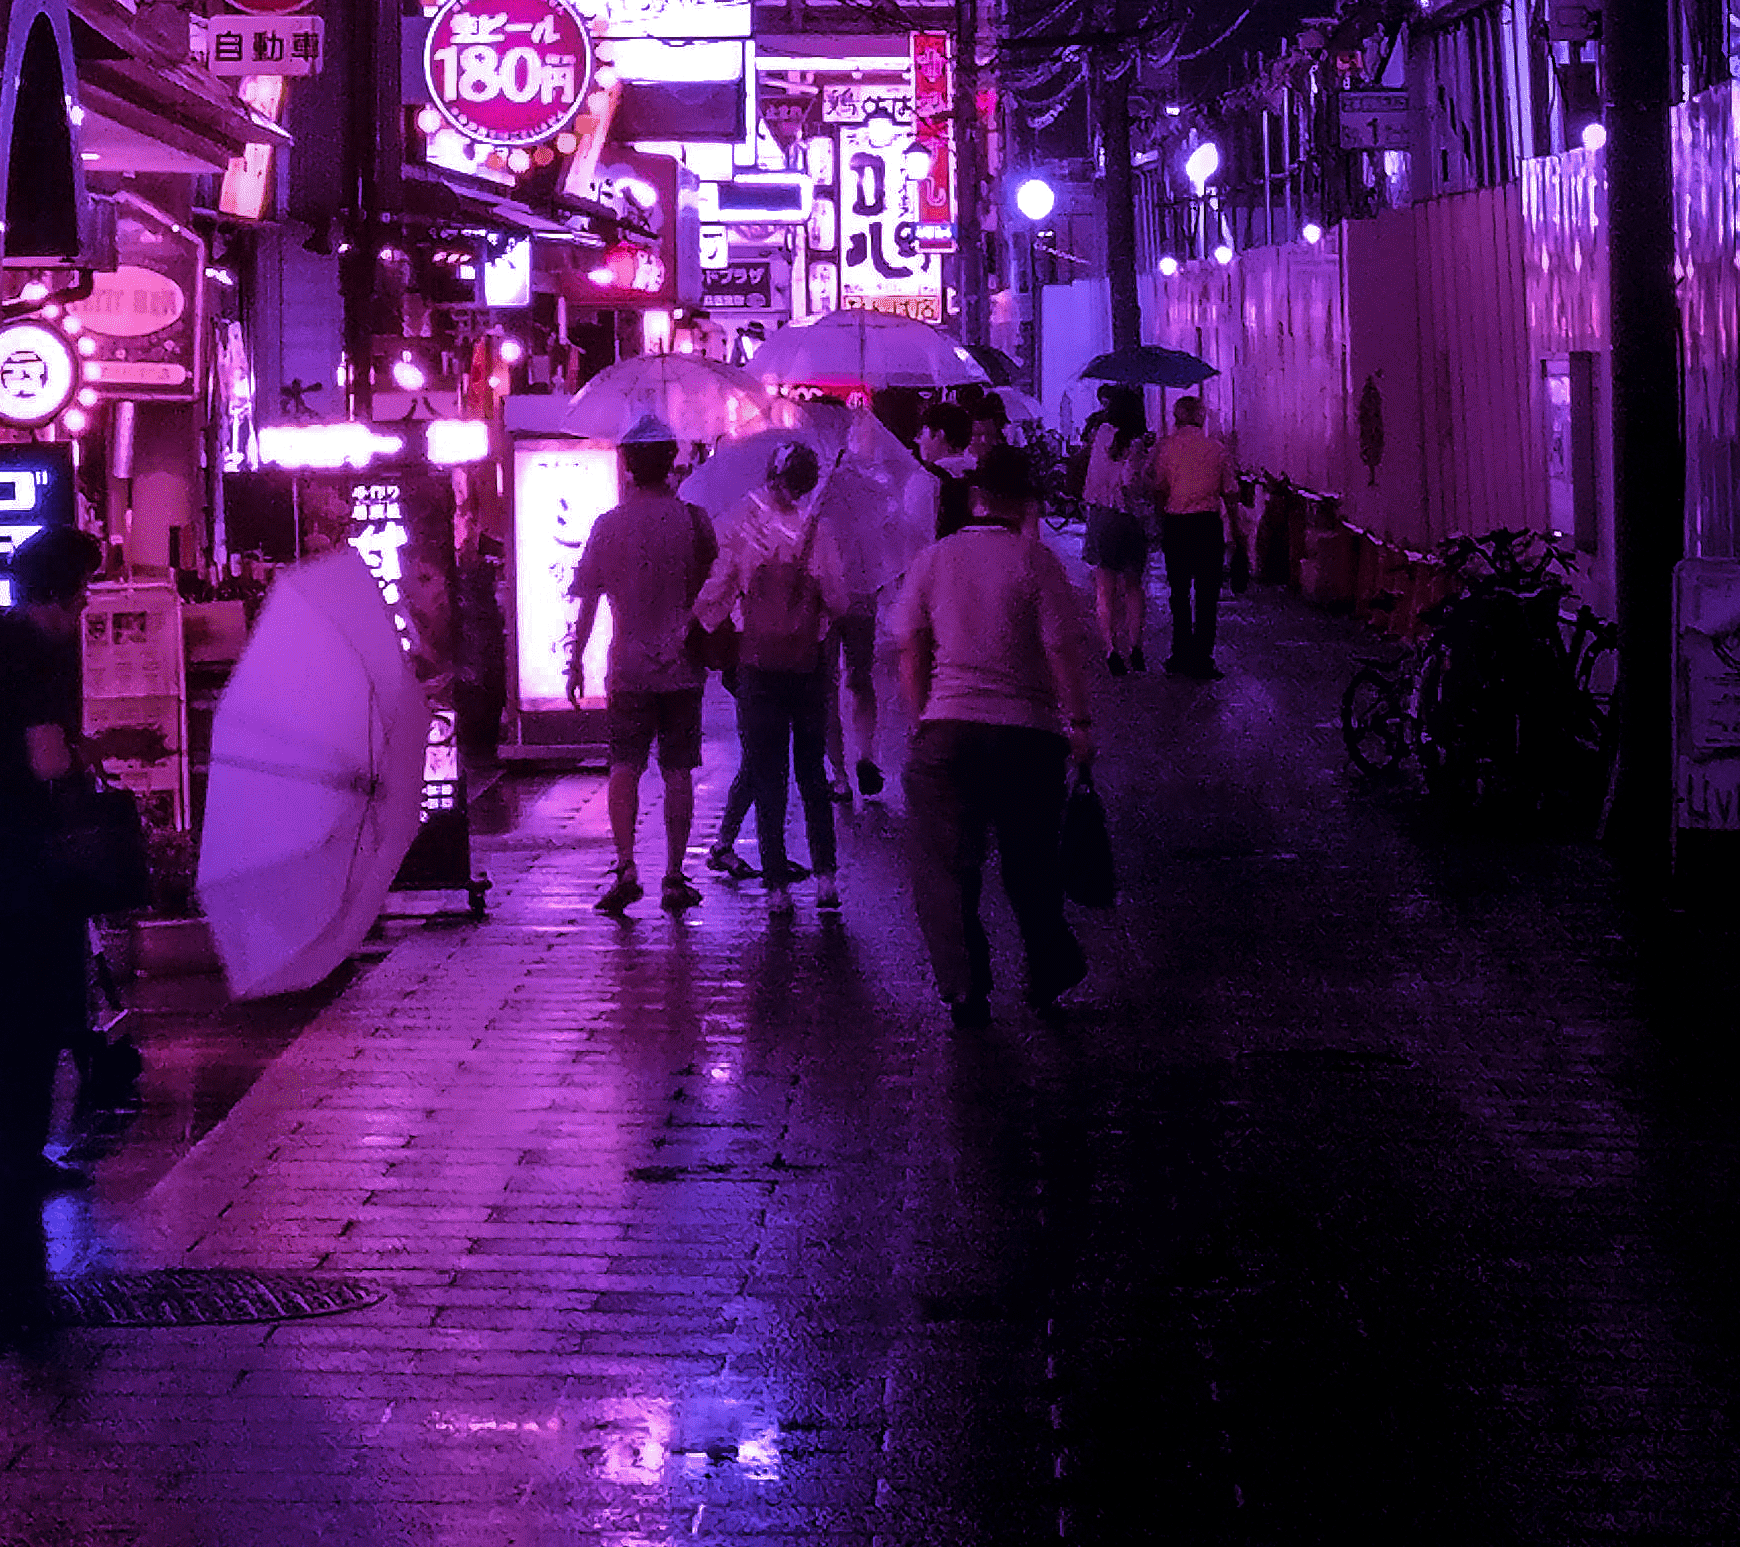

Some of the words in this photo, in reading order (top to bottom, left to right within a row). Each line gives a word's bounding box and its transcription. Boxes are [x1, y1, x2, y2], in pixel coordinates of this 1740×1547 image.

[216, 30, 320, 62] 自動車
[433, 44, 577, 105] 180円
